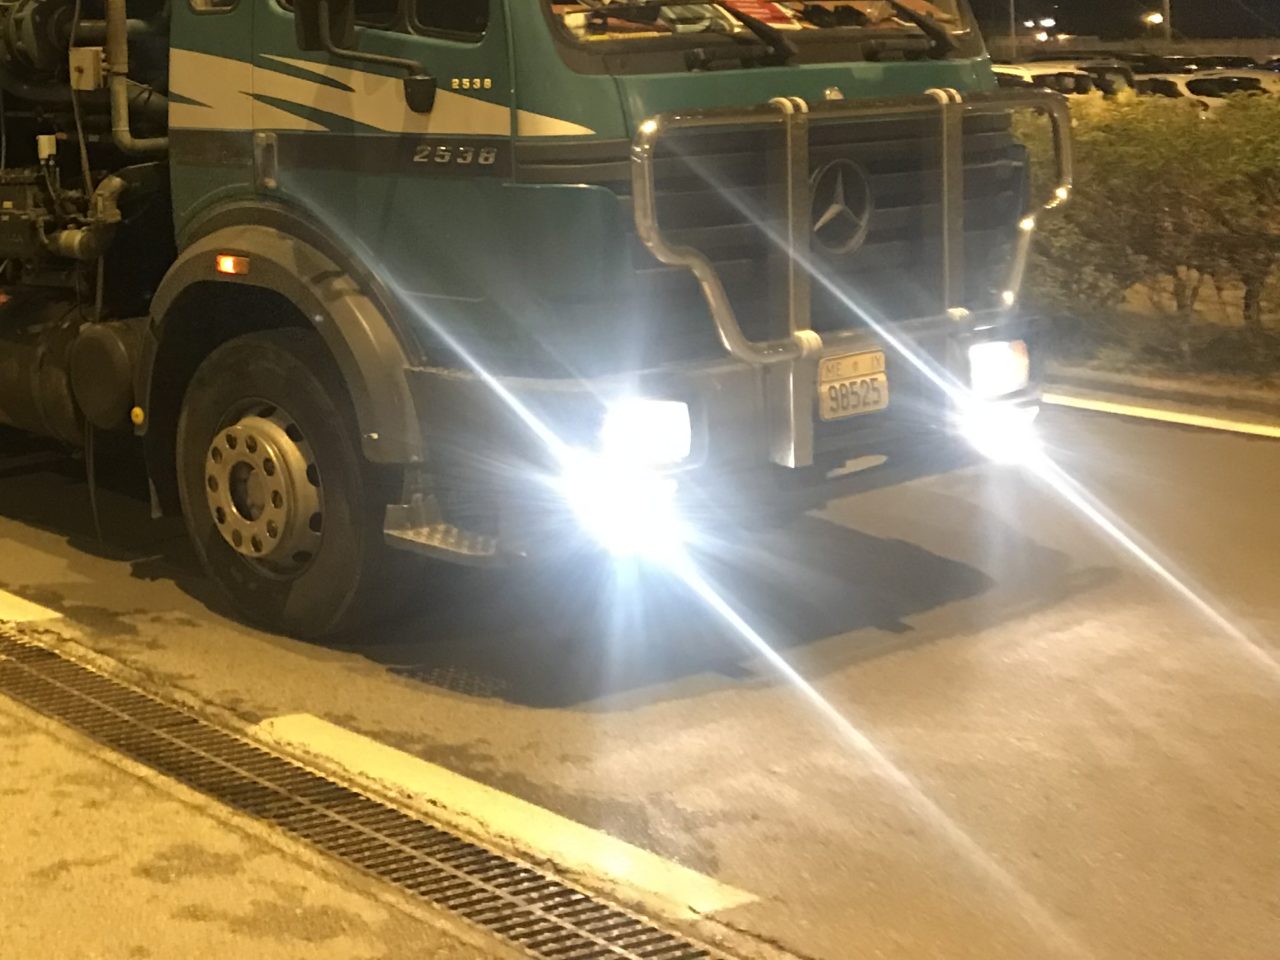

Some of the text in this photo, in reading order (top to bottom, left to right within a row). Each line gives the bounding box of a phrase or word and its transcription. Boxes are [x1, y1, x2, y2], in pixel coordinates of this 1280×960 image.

[450, 77, 493, 90] 2538
[412, 143, 498, 165] 2538
[827, 376, 882, 413] 98525
